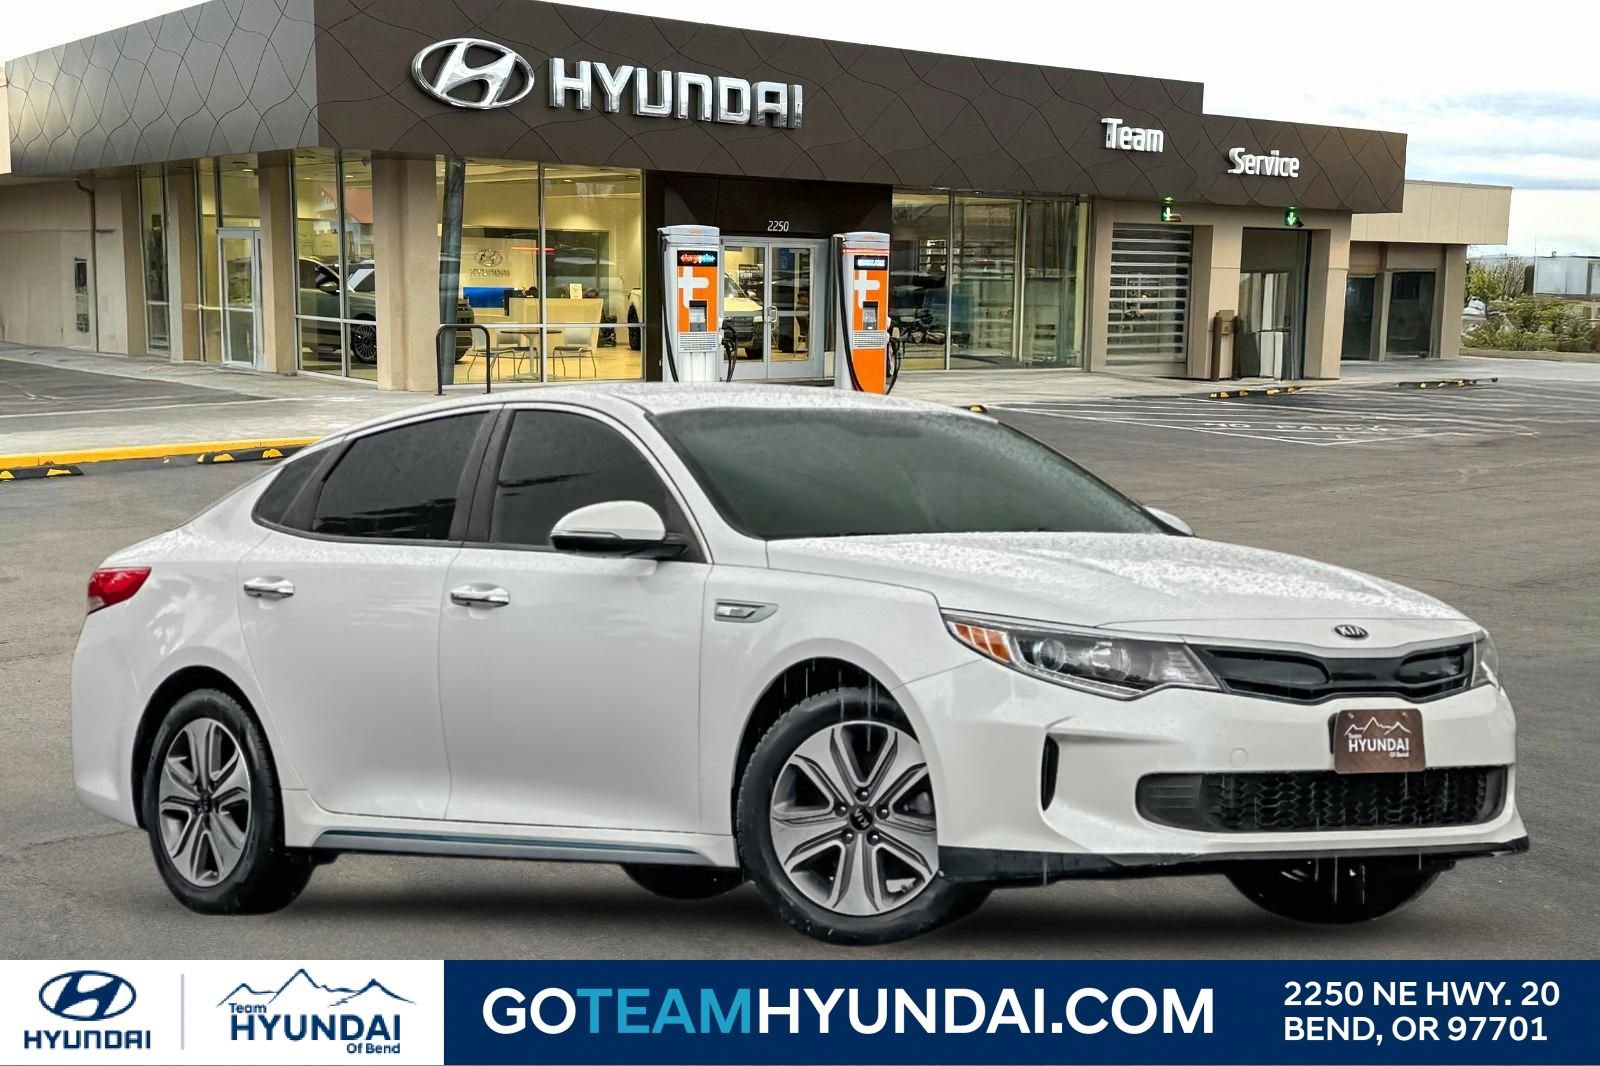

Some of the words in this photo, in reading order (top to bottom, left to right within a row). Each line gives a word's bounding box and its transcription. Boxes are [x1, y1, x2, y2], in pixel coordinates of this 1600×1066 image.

[549, 57, 803, 129] HYUNDAI
[1102, 117, 1164, 152] Team
[1227, 147, 1300, 177] Service
[767, 220, 790, 232] 2250
[1338, 626, 1366, 636] KIA
[1348, 738, 1409, 752] HYUNDAI
